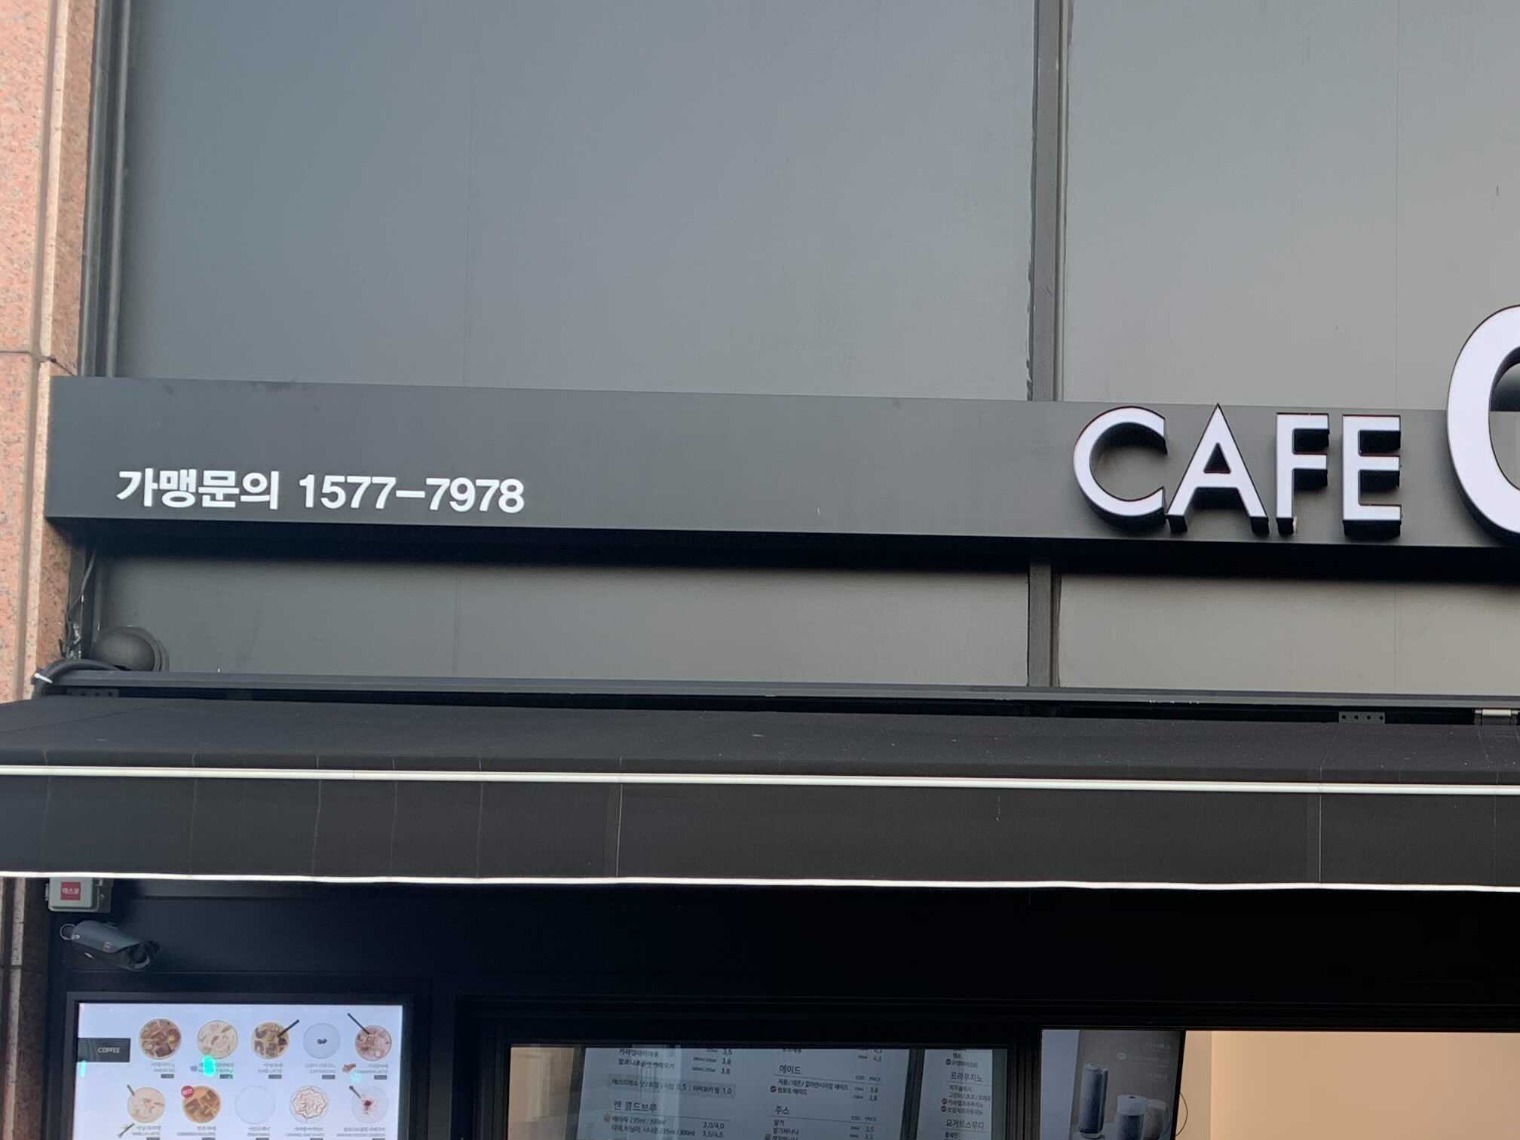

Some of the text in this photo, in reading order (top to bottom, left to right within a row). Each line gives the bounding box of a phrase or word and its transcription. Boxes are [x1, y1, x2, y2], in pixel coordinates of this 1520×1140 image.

[1073, 404, 1402, 536] CAFE
[115, 467, 525, 514] 가맹문의 1577-7978
[779, 1064, 802, 1075] 에이드
[775, 1105, 790, 1115] 주스
